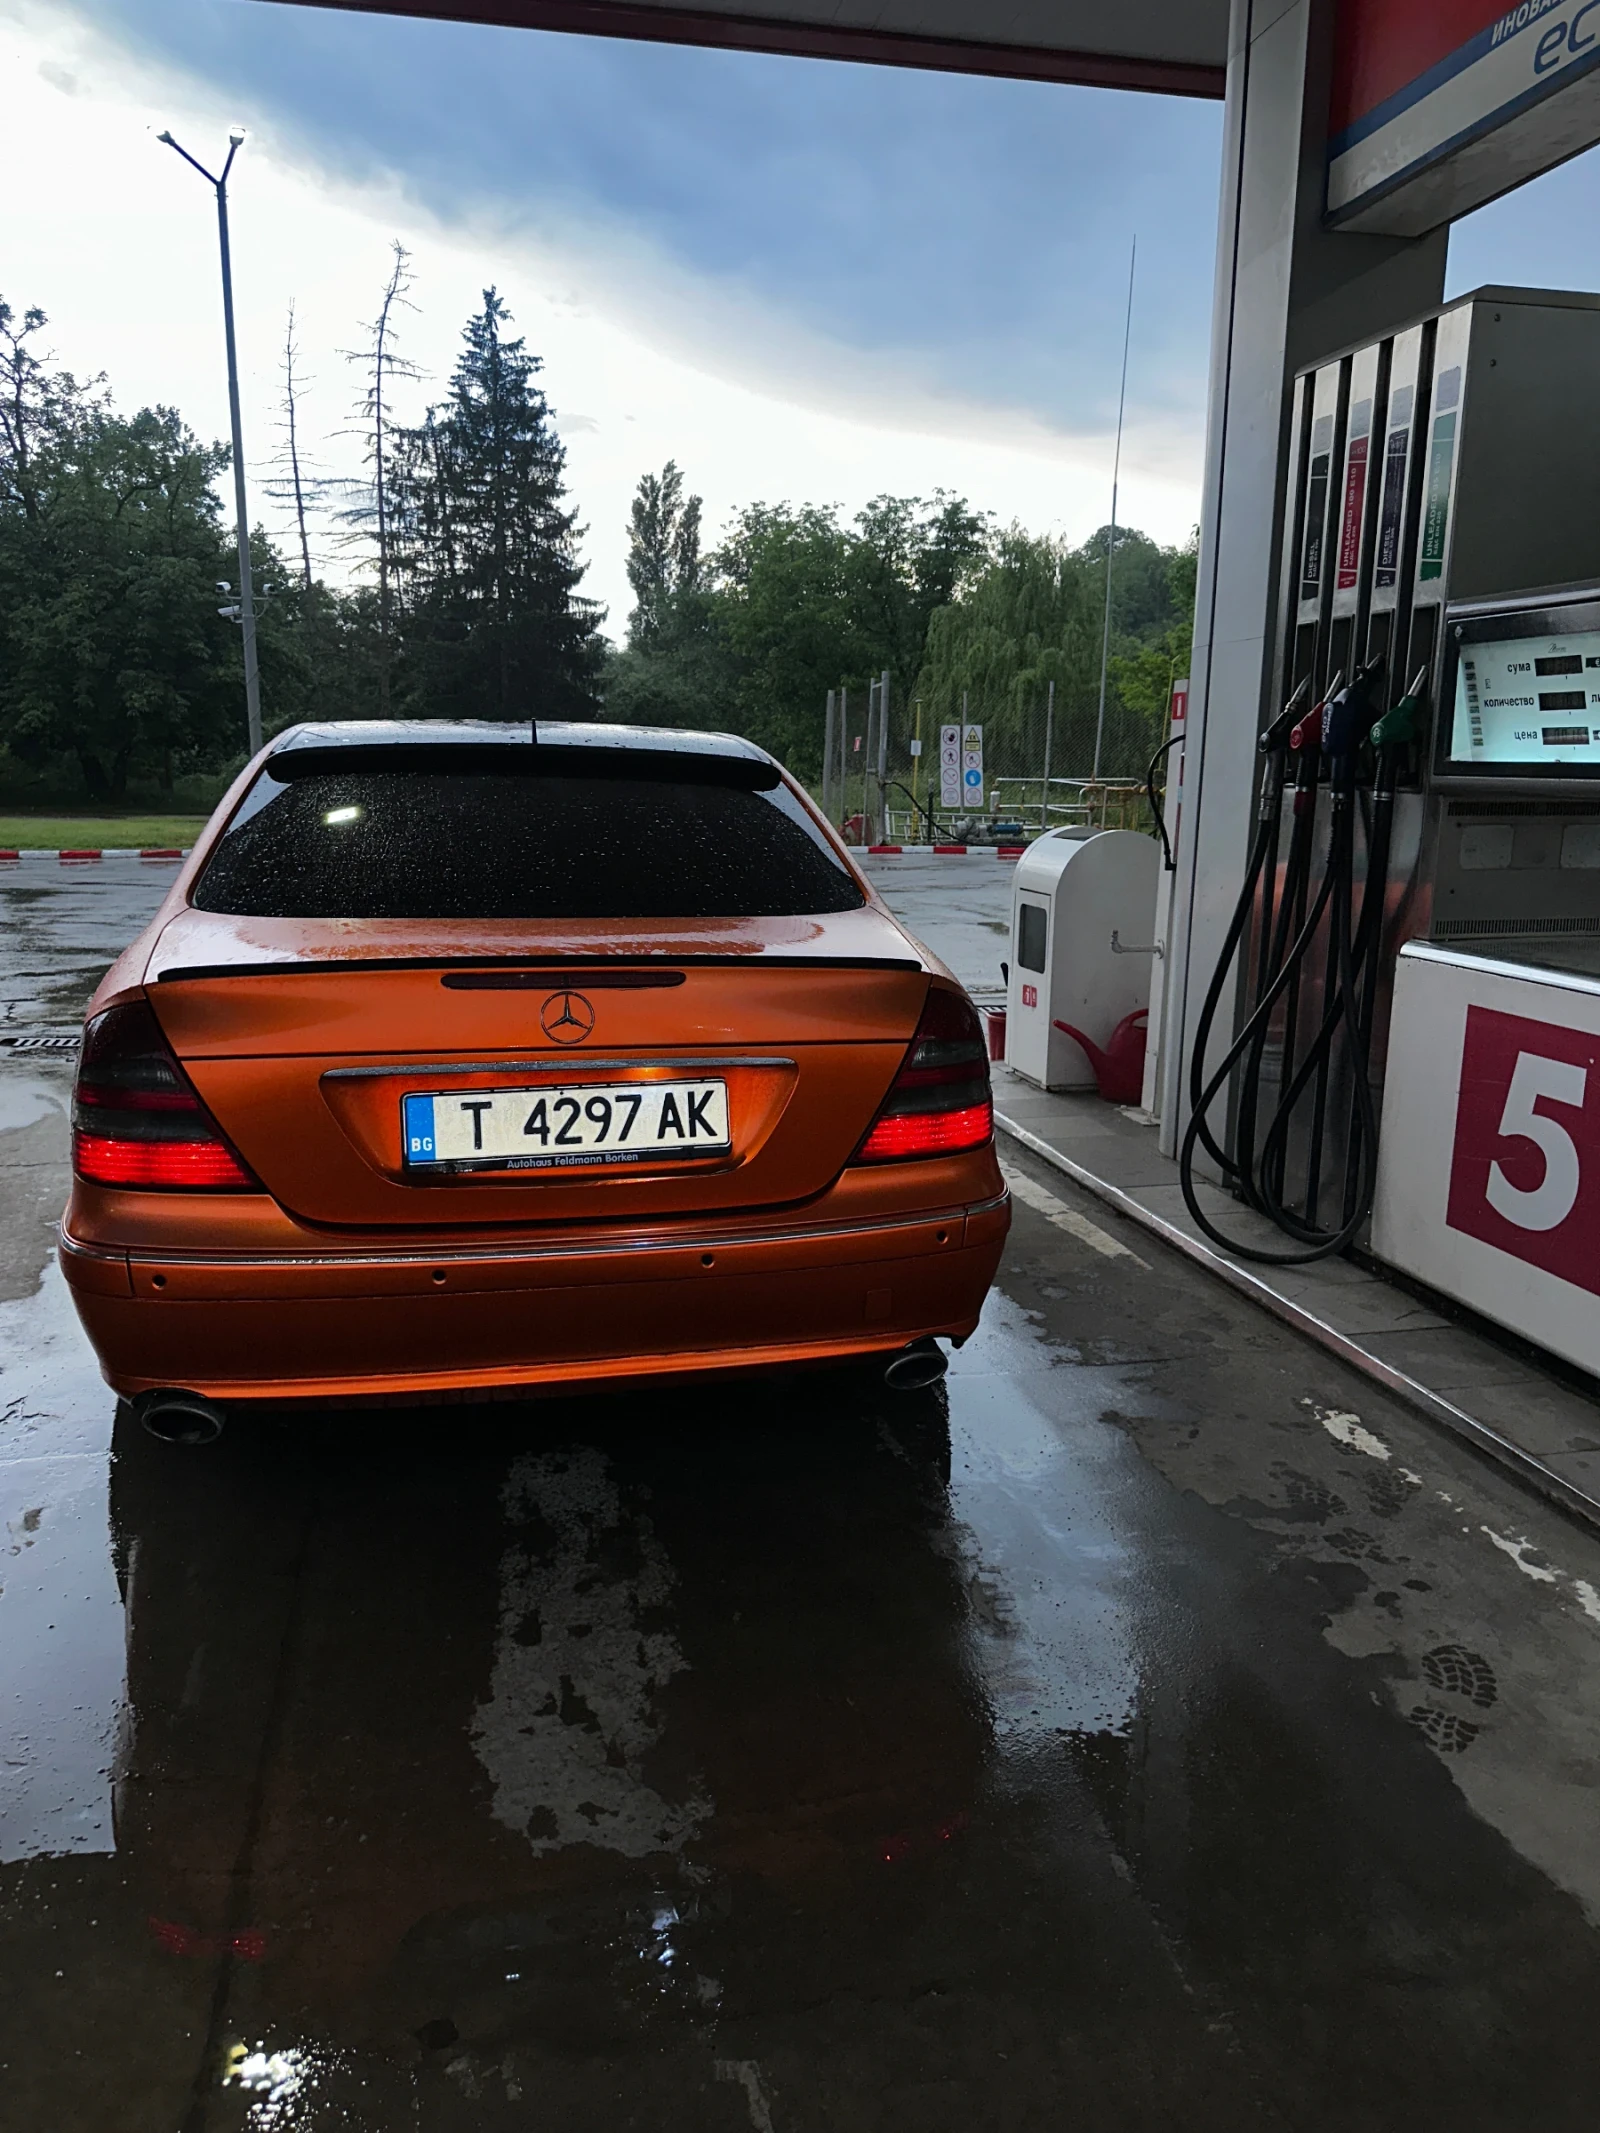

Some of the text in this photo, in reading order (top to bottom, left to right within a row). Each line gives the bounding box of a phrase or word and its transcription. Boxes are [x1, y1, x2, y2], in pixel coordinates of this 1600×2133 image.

[1343, 509, 1353, 567] UNLEADED
[1426, 495, 1437, 557] UNLEADED
[1307, 542, 1316, 579] DIESEL
[1382, 526, 1391, 565] DIESEL
[1507, 662, 1531, 675] сума
[1484, 696, 1534, 708] количество
[1514, 731, 1538, 741] цена
[460, 1090, 718, 1150] T 4297 AK
[411, 1137, 433, 1152] BG
[1485, 1050, 1587, 1231] 5
[507, 1152, 638, 1169] Autohaus Feldmann Borken
